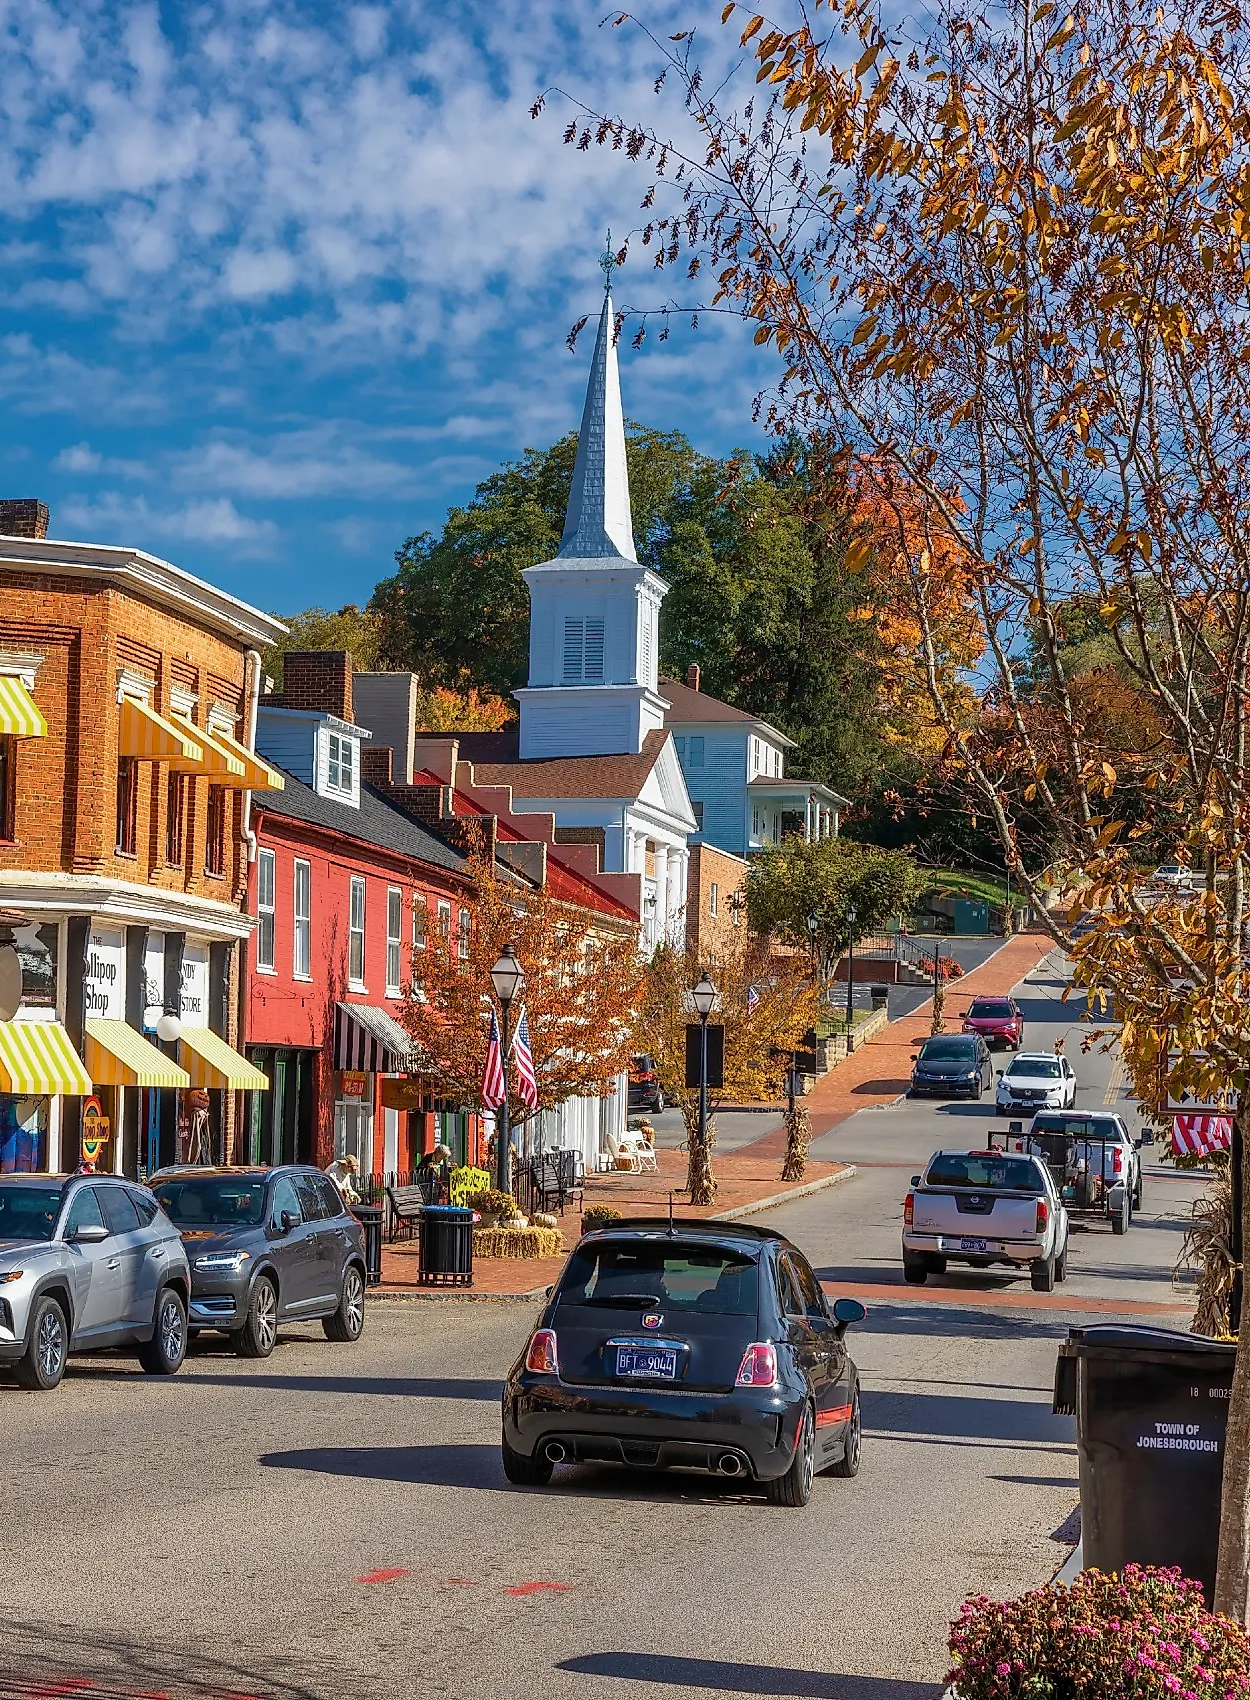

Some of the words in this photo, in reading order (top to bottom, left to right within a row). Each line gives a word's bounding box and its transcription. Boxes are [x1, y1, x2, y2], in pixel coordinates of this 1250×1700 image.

[92, 935, 103, 947] THE
[619, 1354, 639, 1370] BFT
[647, 1356, 672, 1372] 9044
[1190, 1386, 1199, 1397] 18
[1154, 1422, 1185, 1436] TOWN
[1185, 1424, 1200, 1436] OF
[1136, 1436, 1218, 1453] JONESBOROUGH
